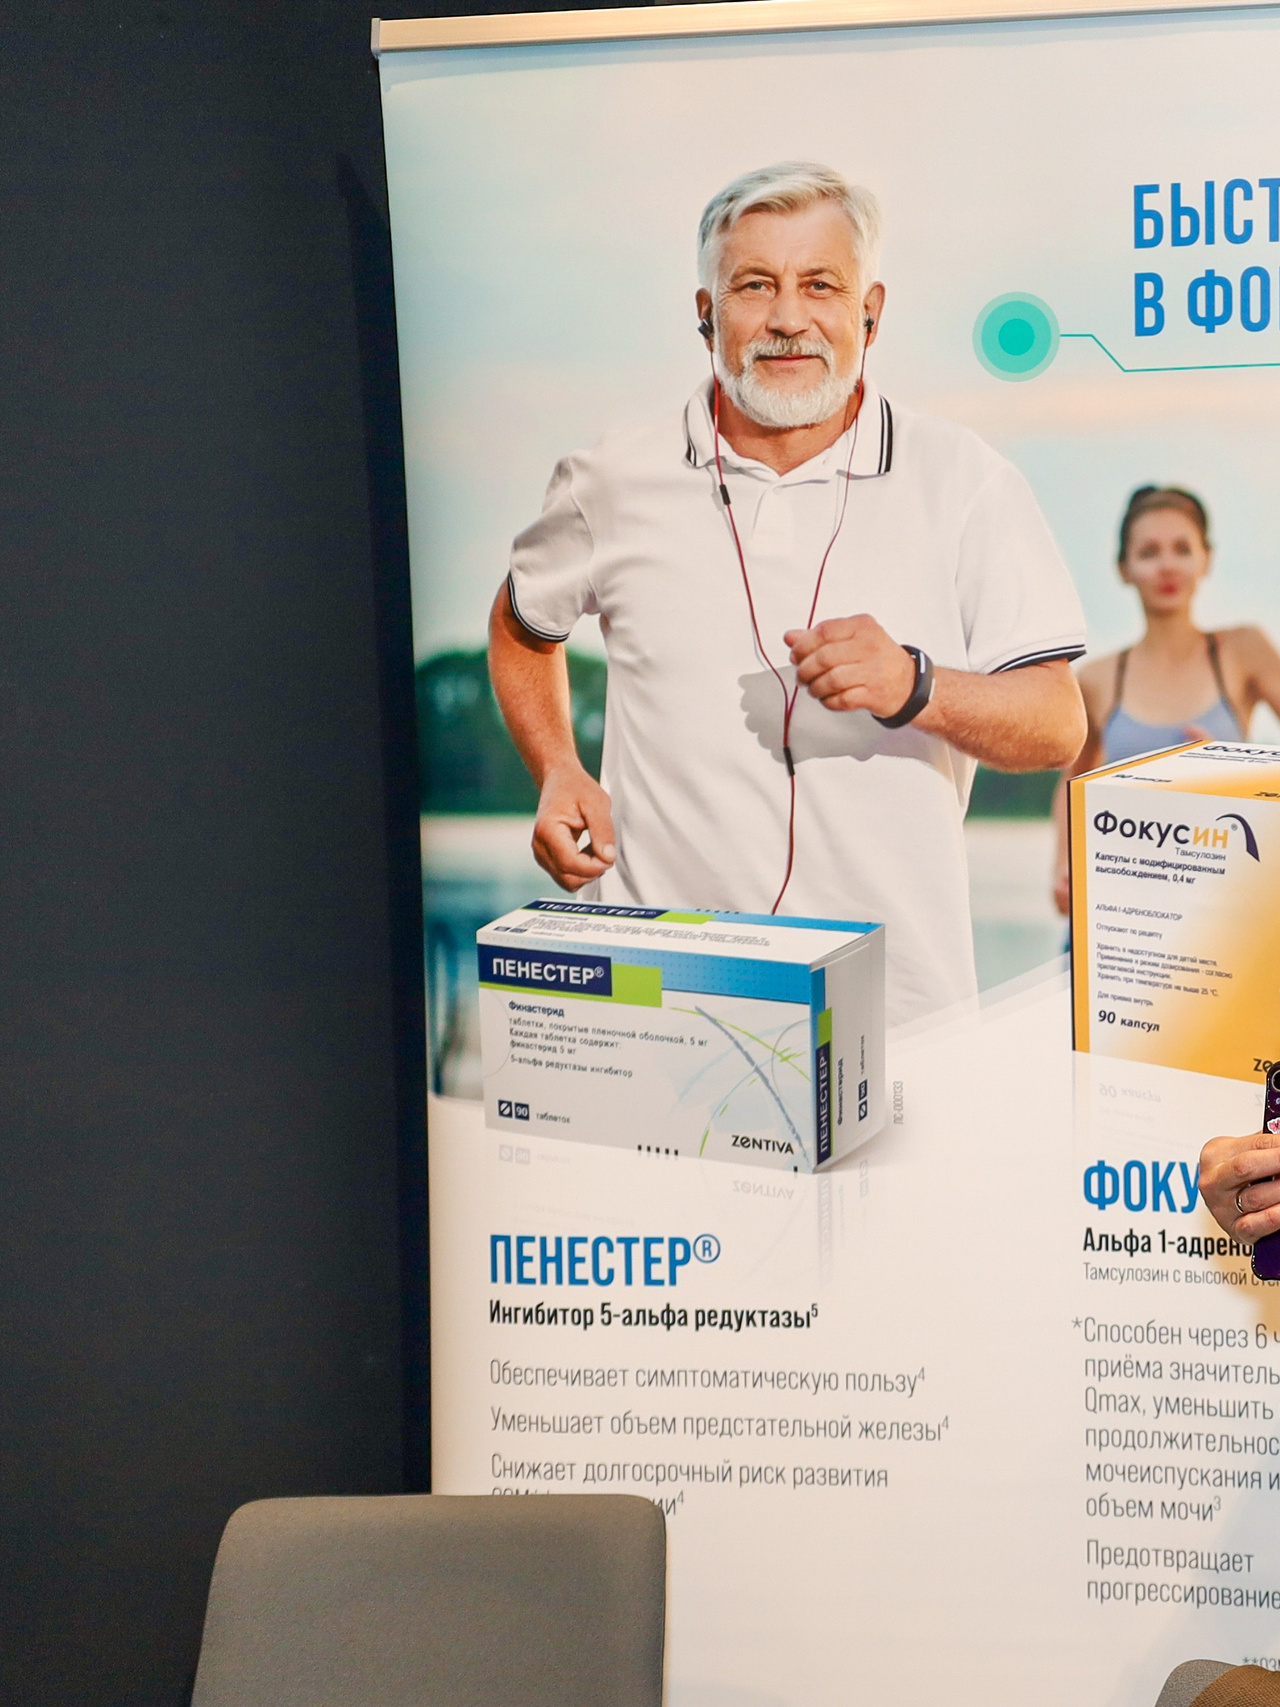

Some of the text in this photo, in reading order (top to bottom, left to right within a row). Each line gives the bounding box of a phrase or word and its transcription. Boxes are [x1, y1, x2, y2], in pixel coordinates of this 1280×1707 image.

[1134, 272, 1164, 336] В
[1096, 852, 1130, 863] Капсулы
[1140, 858, 1225, 875] модифицированным
[1175, 847, 1226, 860] Тамсулозин
[1096, 866, 1170, 882] высвобождением,
[1173, 874, 1184, 883] 0,4
[1096, 923, 1128, 934] Отпускают
[1139, 930, 1162, 940] рецепту
[1096, 942, 1120, 952] Хранить
[492, 958, 604, 985] ПЕНЕСТЕР®
[1123, 976, 1133, 984] при
[509, 1001, 564, 1017] Финастерид
[1098, 1010, 1160, 1032] 90 капсул
[509, 1018, 547, 1030] таблетки,
[549, 1023, 588, 1034] покрытые
[592, 1027, 636, 1039] пленочной
[639, 1032, 687, 1045] оболочкой,
[698, 1039, 707, 1047] мг
[510, 1028, 537, 1039] Каждая
[541, 1033, 576, 1044] таблетка
[510, 1040, 557, 1053] финастерид
[560, 1045, 564, 1053] 5
[511, 1055, 632, 1078] 5-альфа редуктазы ингибитор
[516, 1106, 570, 1123] 90 таблеток
[1083, 1160, 1200, 1214] ФОКУ
[1083, 1227, 1151, 1256] Альфа
[490, 1234, 720, 1287] ПЕНЕСТЕР®
[1084, 1262, 1169, 1284] Тамсулозин
[1173, 1270, 1181, 1283] с
[1185, 1267, 1247, 1287] высокой
[490, 1300, 594, 1331] Ингибитор
[601, 1304, 688, 1332] 5-альфа
[1188, 1327, 1248, 1351] через
[1255, 1324, 1267, 1349] 6
[490, 1360, 629, 1388] Обеспечивает
[636, 1367, 839, 1396] симптоматическую
[1085, 1354, 1162, 1380] приёма
[1085, 1387, 1146, 1416] Qmax,
[1153, 1396, 1273, 1420] уменьшить
[491, 1407, 603, 1434] Уменьшает
[611, 1412, 676, 1436] объем
[683, 1416, 851, 1449] предстательной
[491, 1454, 888, 1490] Снижает долгосрочный риск развития
[1086, 1463, 1261, 1490] мочеиспускания
[1269, 1472, 1280, 1491] и
[1086, 1495, 1153, 1518] объем
[1086, 1539, 1254, 1573] Предотвращает
